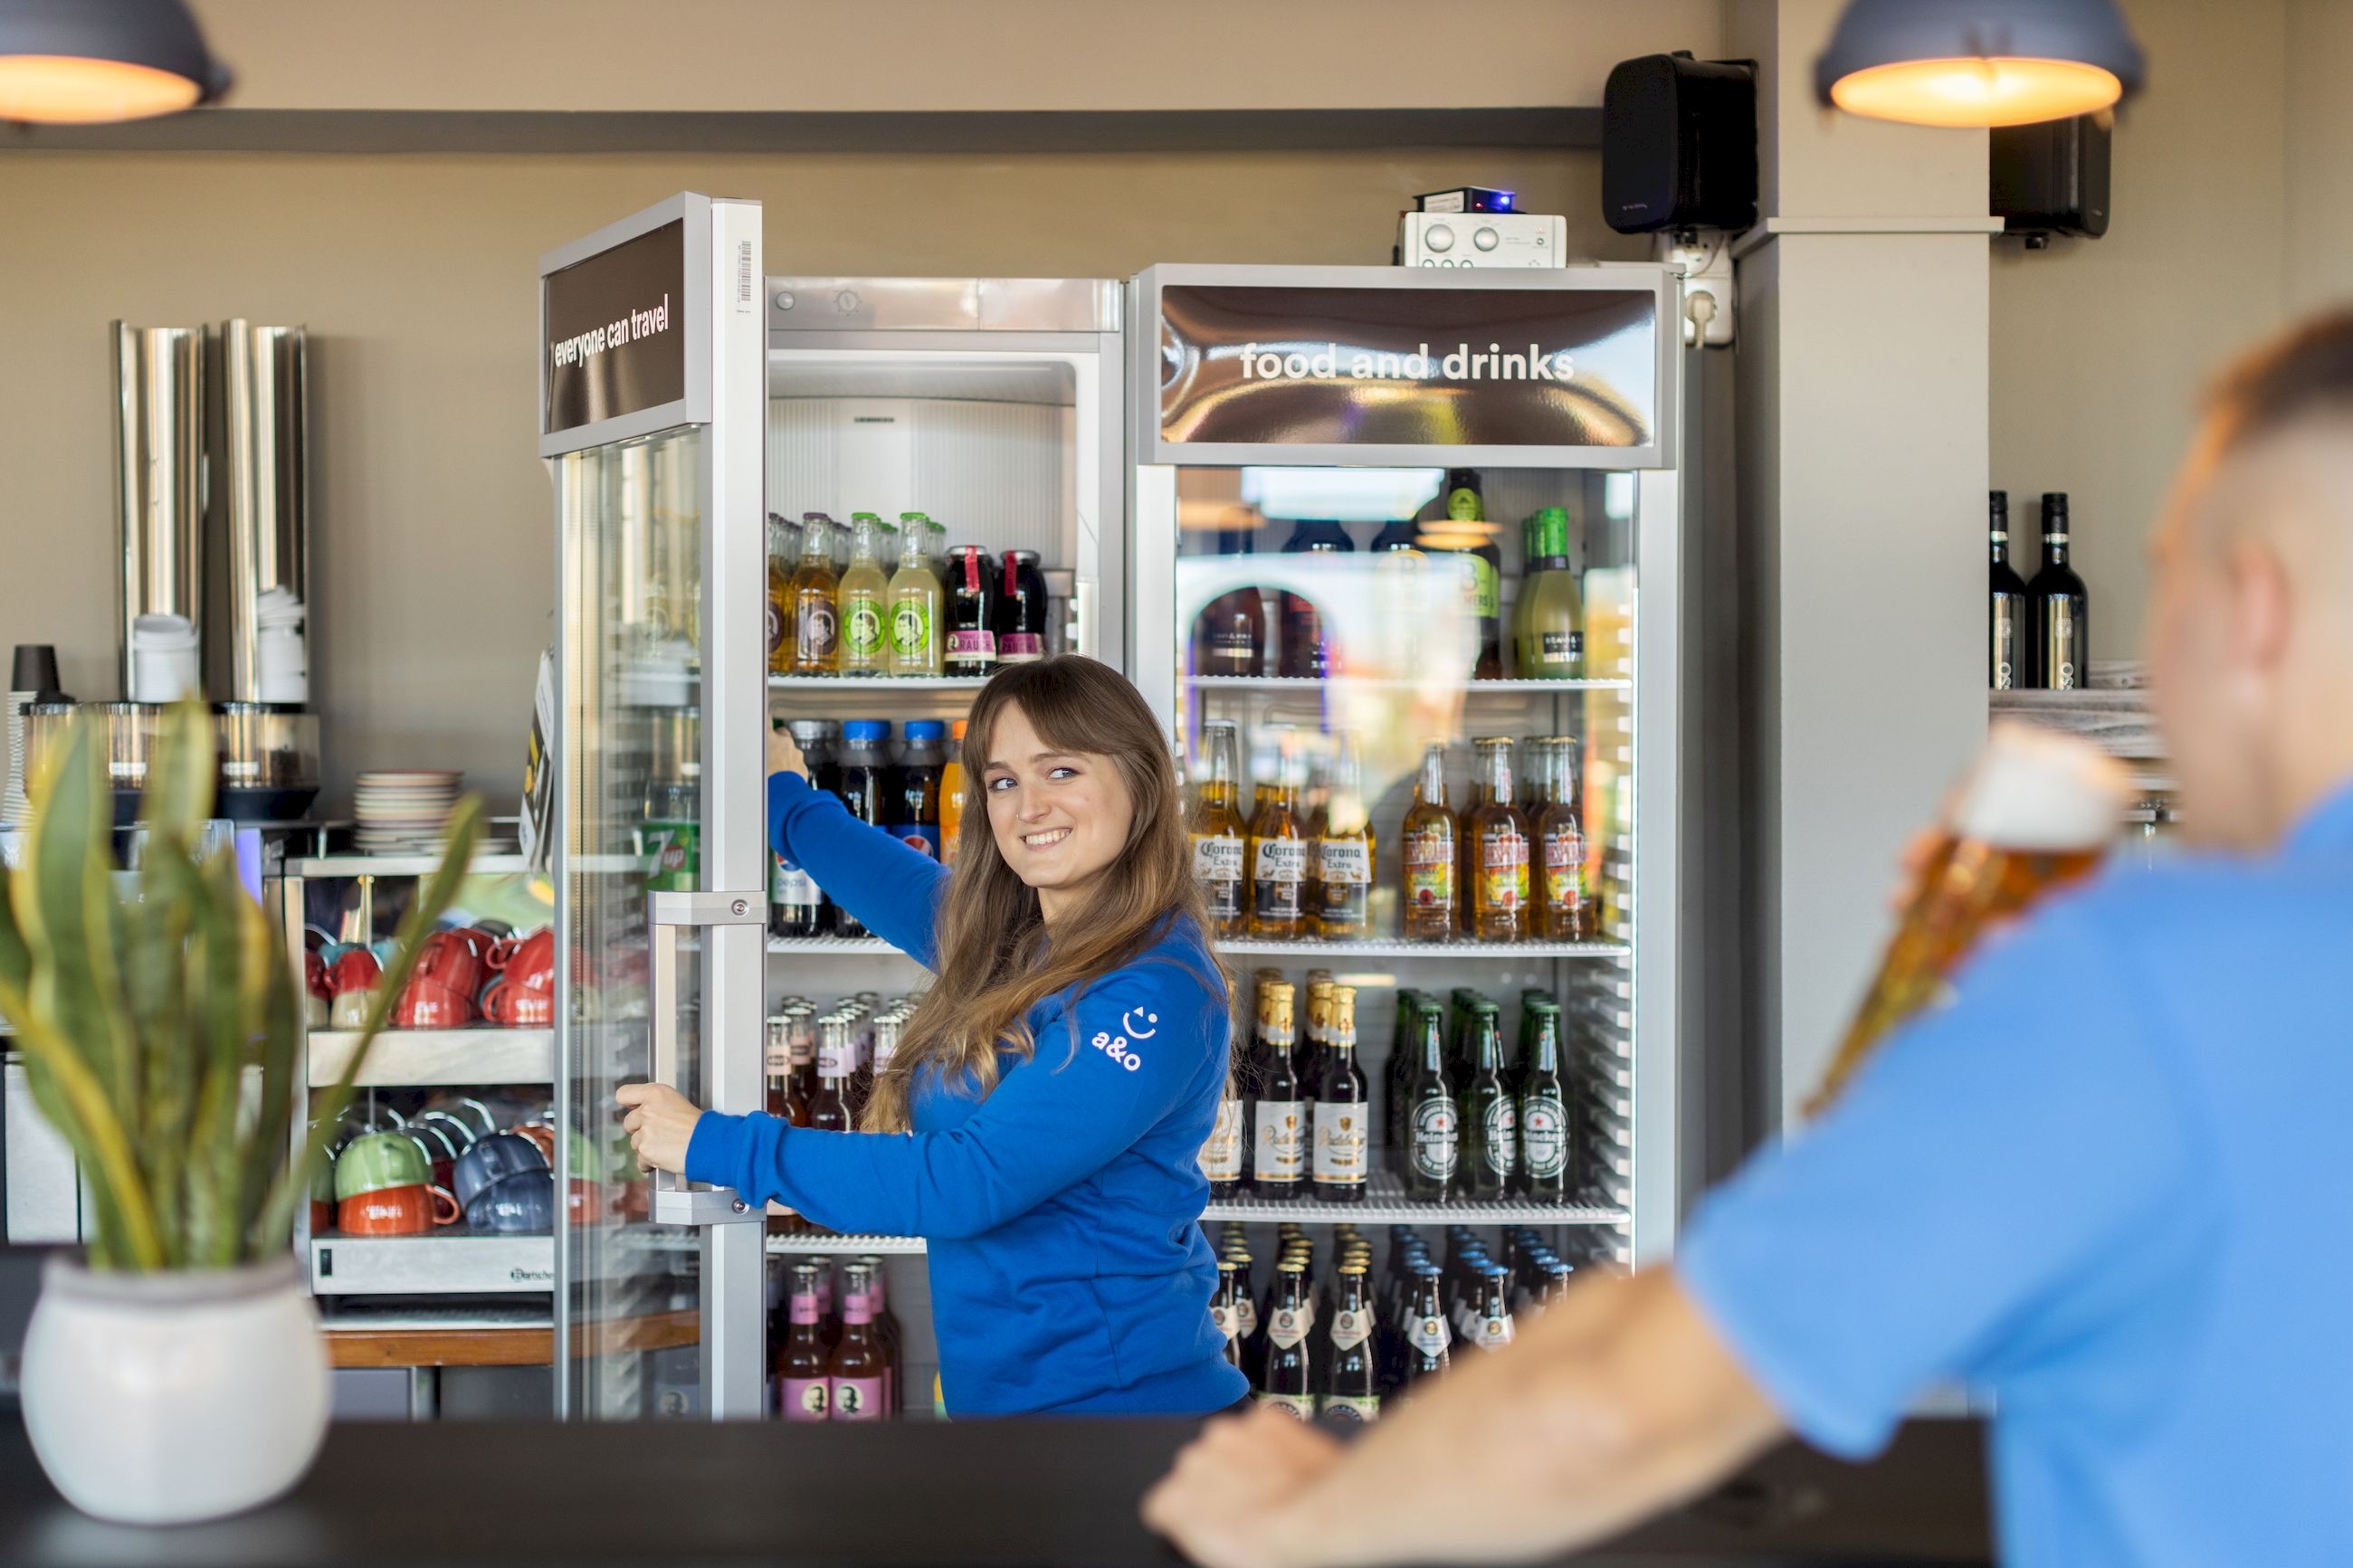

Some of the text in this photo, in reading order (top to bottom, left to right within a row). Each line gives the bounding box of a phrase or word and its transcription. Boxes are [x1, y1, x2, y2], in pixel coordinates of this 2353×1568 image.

[555, 293, 669, 368] everyone can travel
[1240, 342, 1575, 381] food and drinks
[1200, 841, 1243, 858] Coron
[1262, 842, 1306, 859] Coron
[1091, 1031, 1141, 1071] a&o
